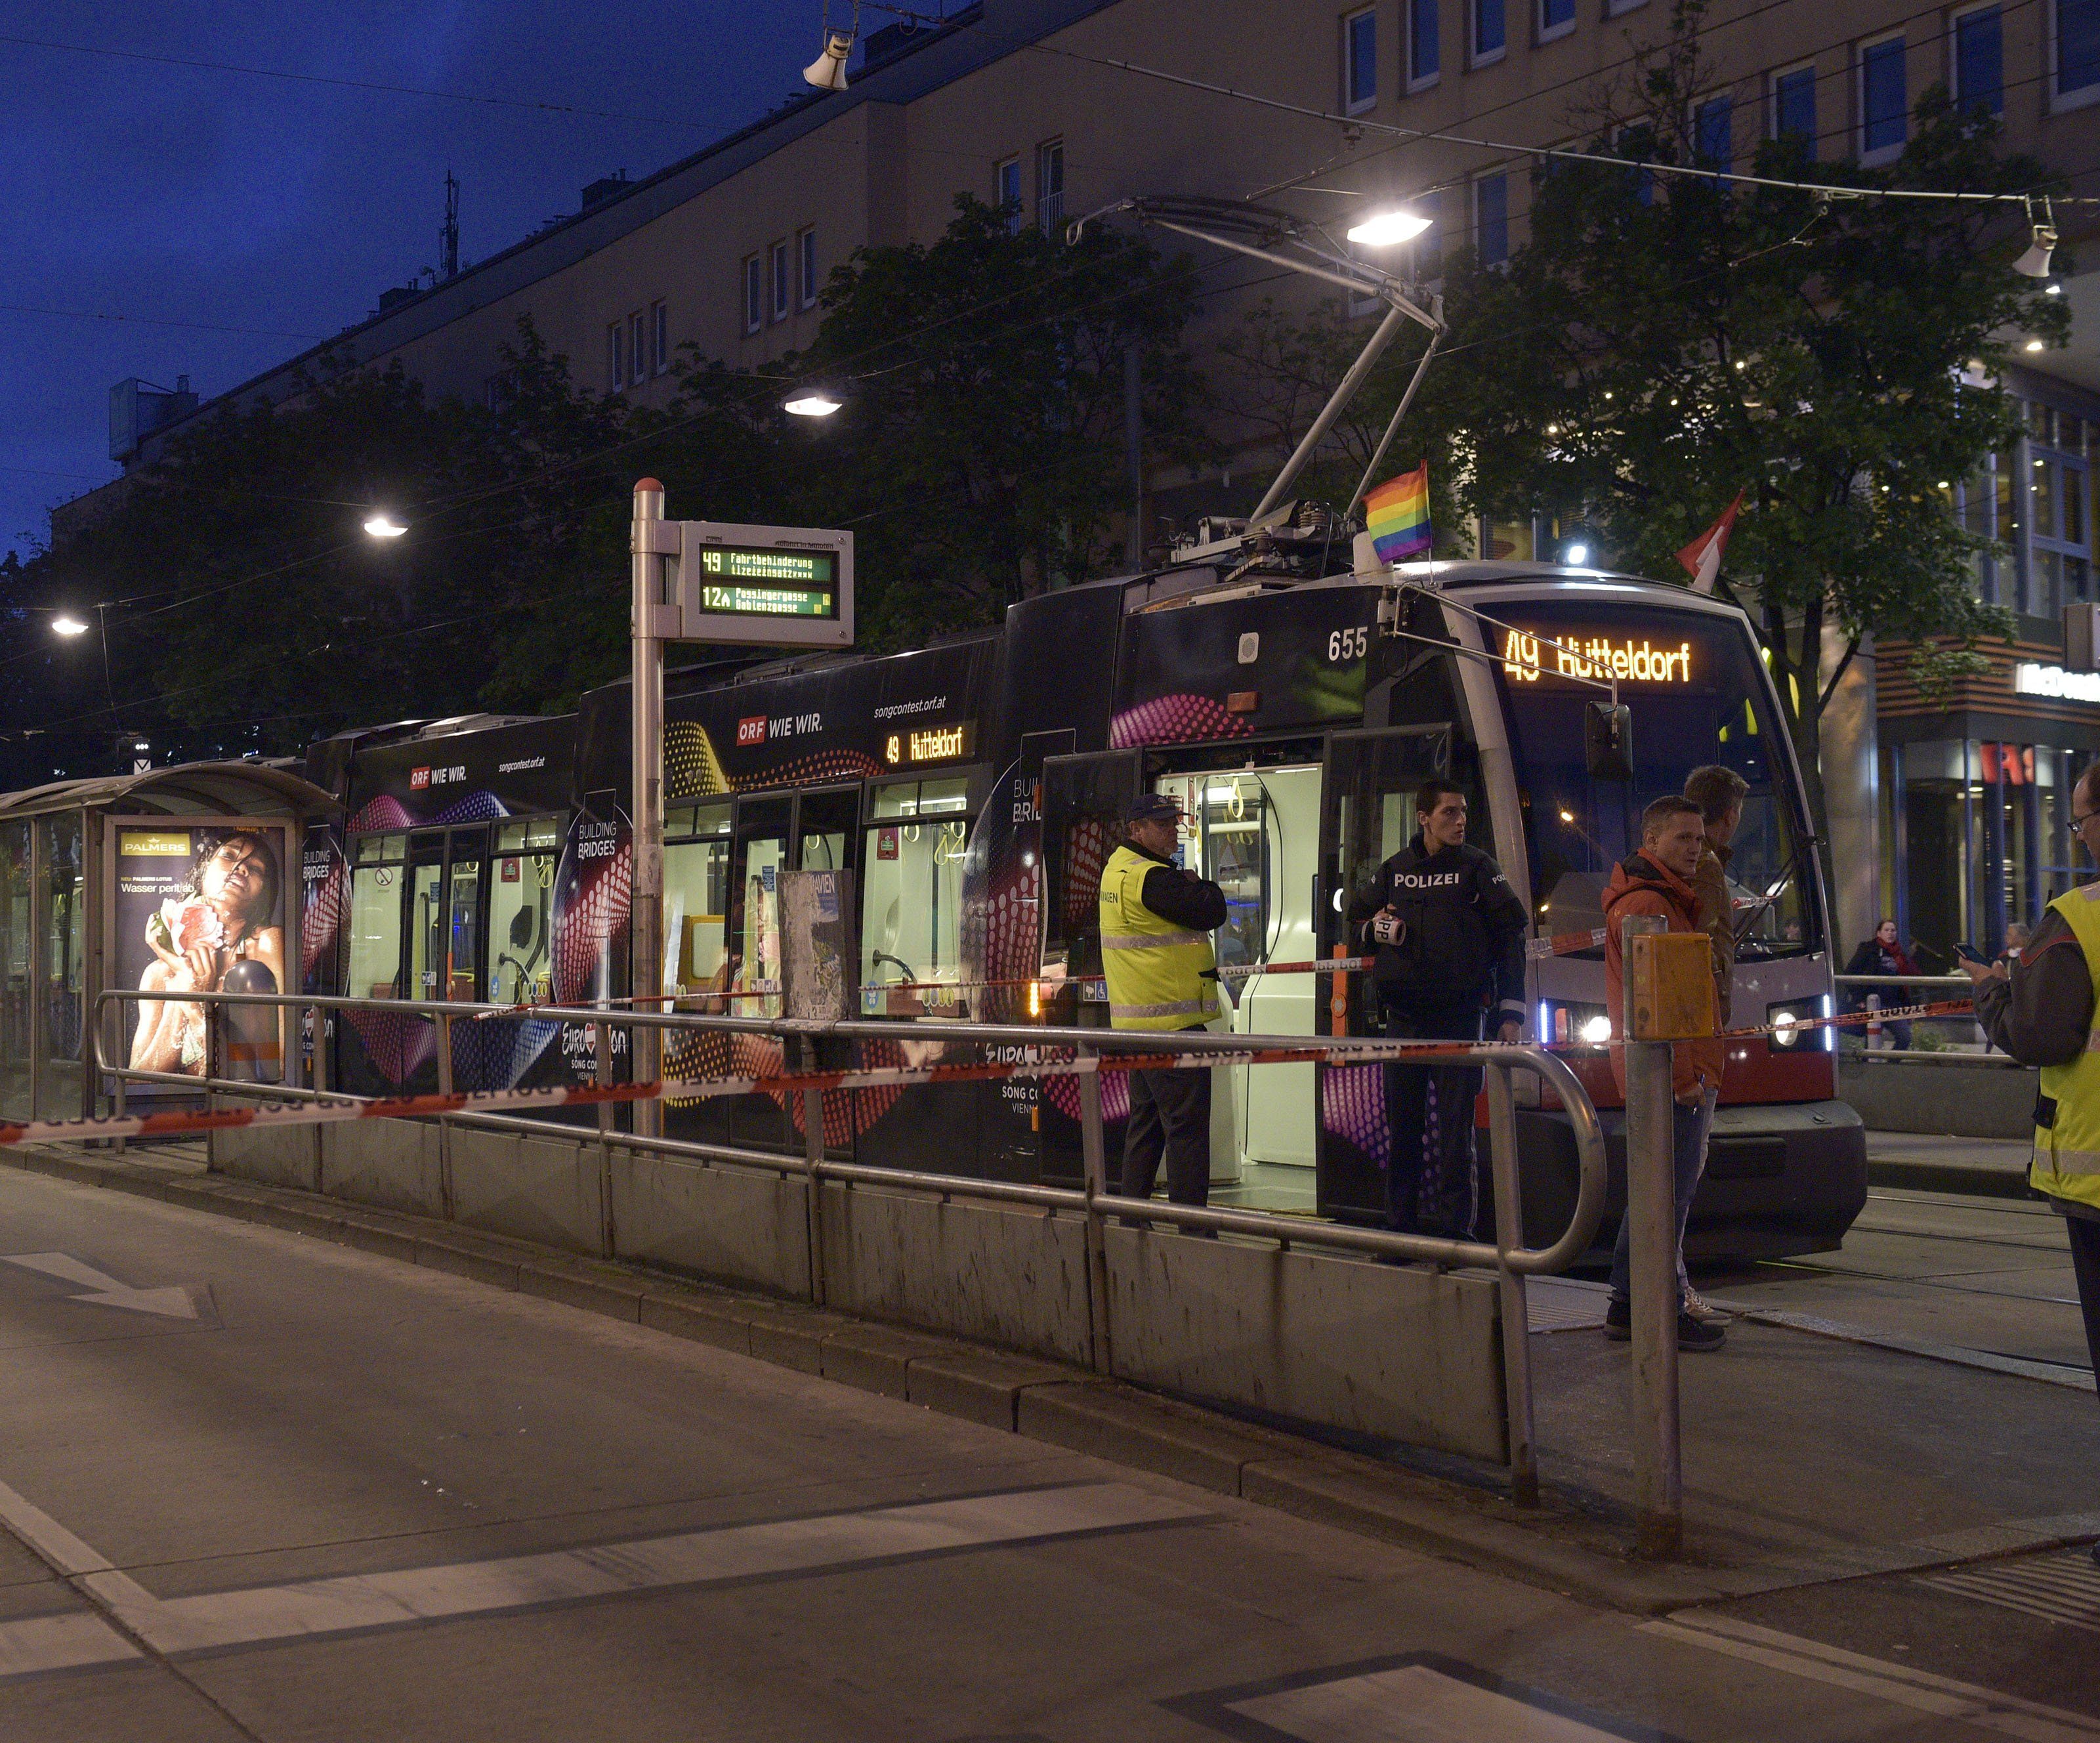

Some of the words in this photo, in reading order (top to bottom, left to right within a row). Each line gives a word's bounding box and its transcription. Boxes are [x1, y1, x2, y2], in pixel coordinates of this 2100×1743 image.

[703, 552, 721, 572] 49
[730, 553, 813, 570] Fahrtbehinderung
[1329, 627, 1368, 661] 655
[1505, 629, 1539, 681] 49
[1556, 636, 1690, 682] Hütteldorf
[874, 696, 946, 719] songcontest.orf.at
[740, 721, 765, 740] ORF
[769, 717, 791, 738] WIE
[796, 713, 822, 734] WIR.
[887, 736, 899, 764] 49
[911, 726, 962, 761] Hütteldorf
[499, 757, 545, 773] songcontest.orf.at
[411, 770, 429, 786] ORF
[431, 768, 446, 784] WIE
[449, 766, 467, 782] WIR.
[579, 821, 617, 839] BUILDING
[125, 843, 186, 852] PALMERS
[578, 840, 616, 860] BRIDGES
[303, 850, 330, 864] BUILDING
[303, 865, 329, 879] BRIDGES
[1394, 873, 1459, 888] POLIZEI
[121, 883, 158, 892] Wasser
[571, 1059, 586, 1069] SONG
[1002, 1086, 1026, 1099] SONG
